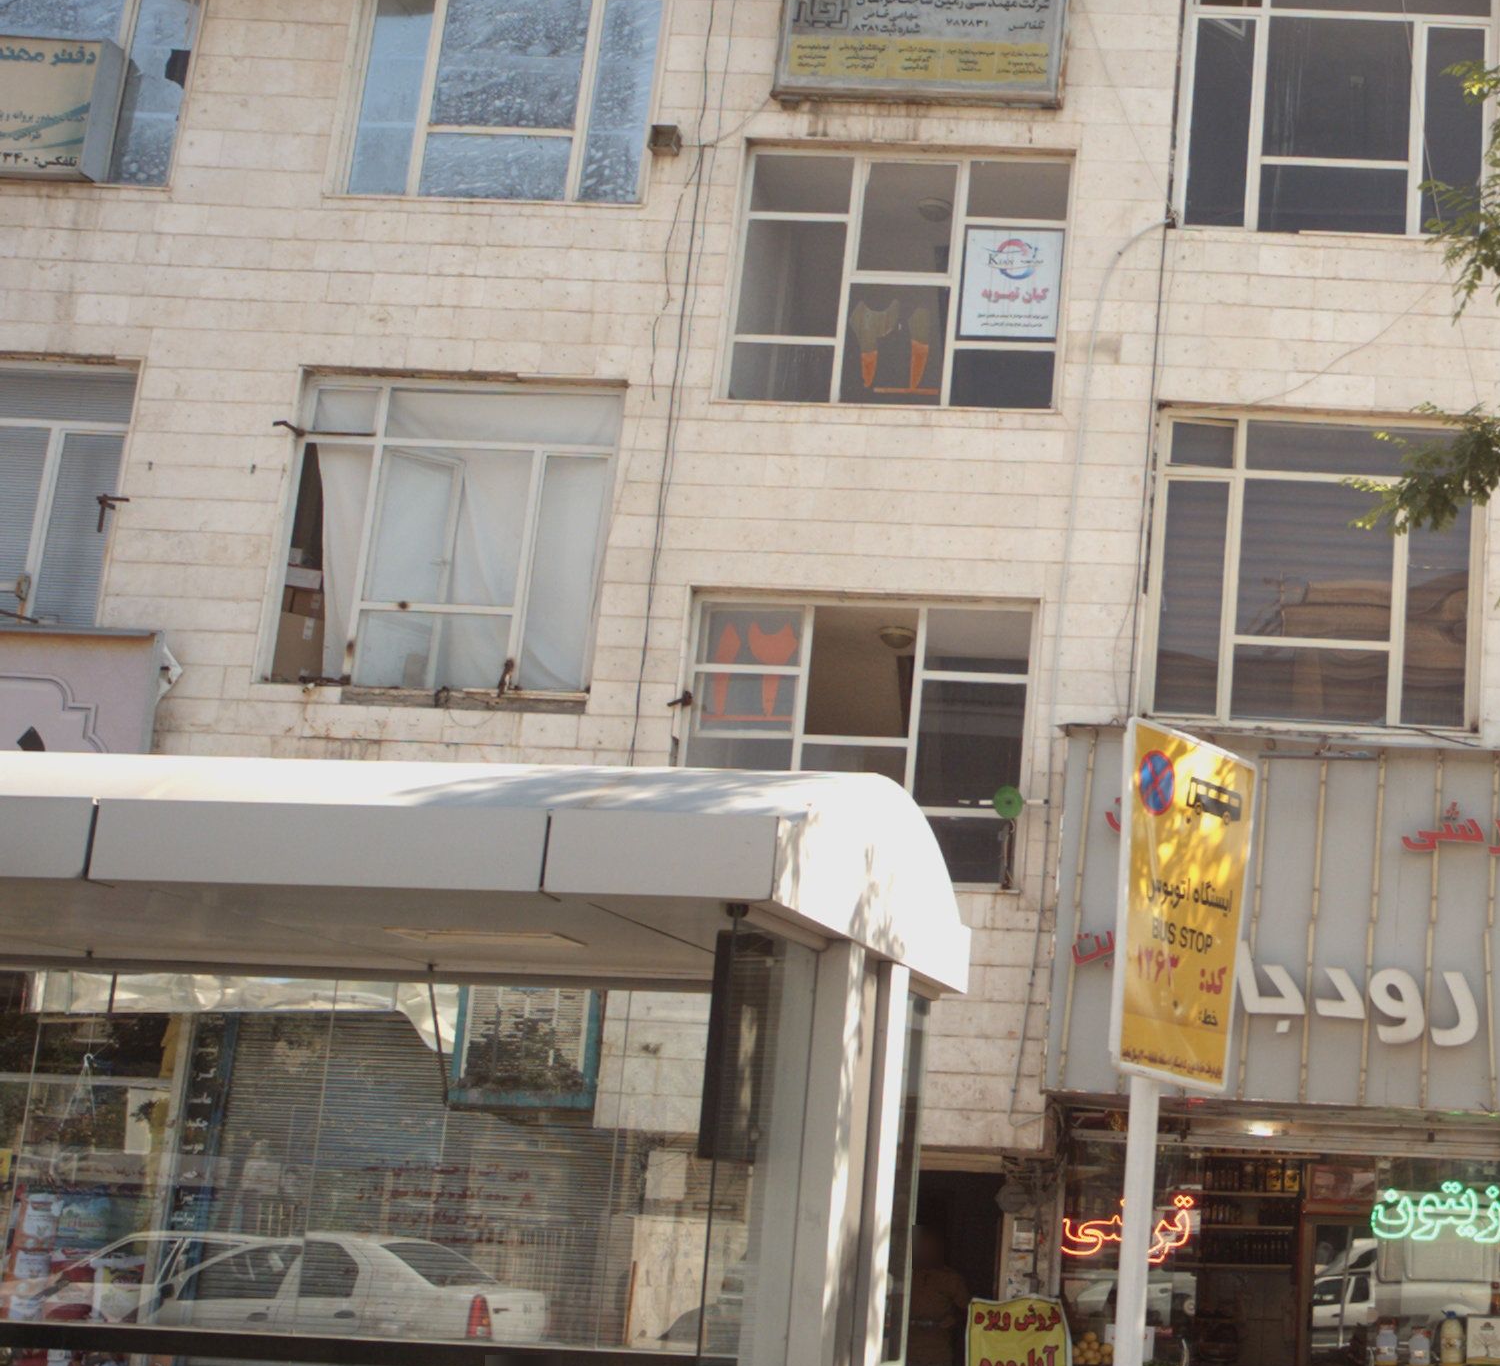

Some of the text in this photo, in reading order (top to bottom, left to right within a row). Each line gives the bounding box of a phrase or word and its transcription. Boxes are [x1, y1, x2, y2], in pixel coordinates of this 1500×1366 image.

[49, 45, 97, 65] دفتر
[1192, 881, 1234, 918] ایستگاه
[1152, 917, 1213, 955] BUS STOP
[1237, 938, 1480, 1047] رودبا
[1061, 1193, 1196, 1263] تری
[974, 1304, 1062, 1332] فروش ویژه
